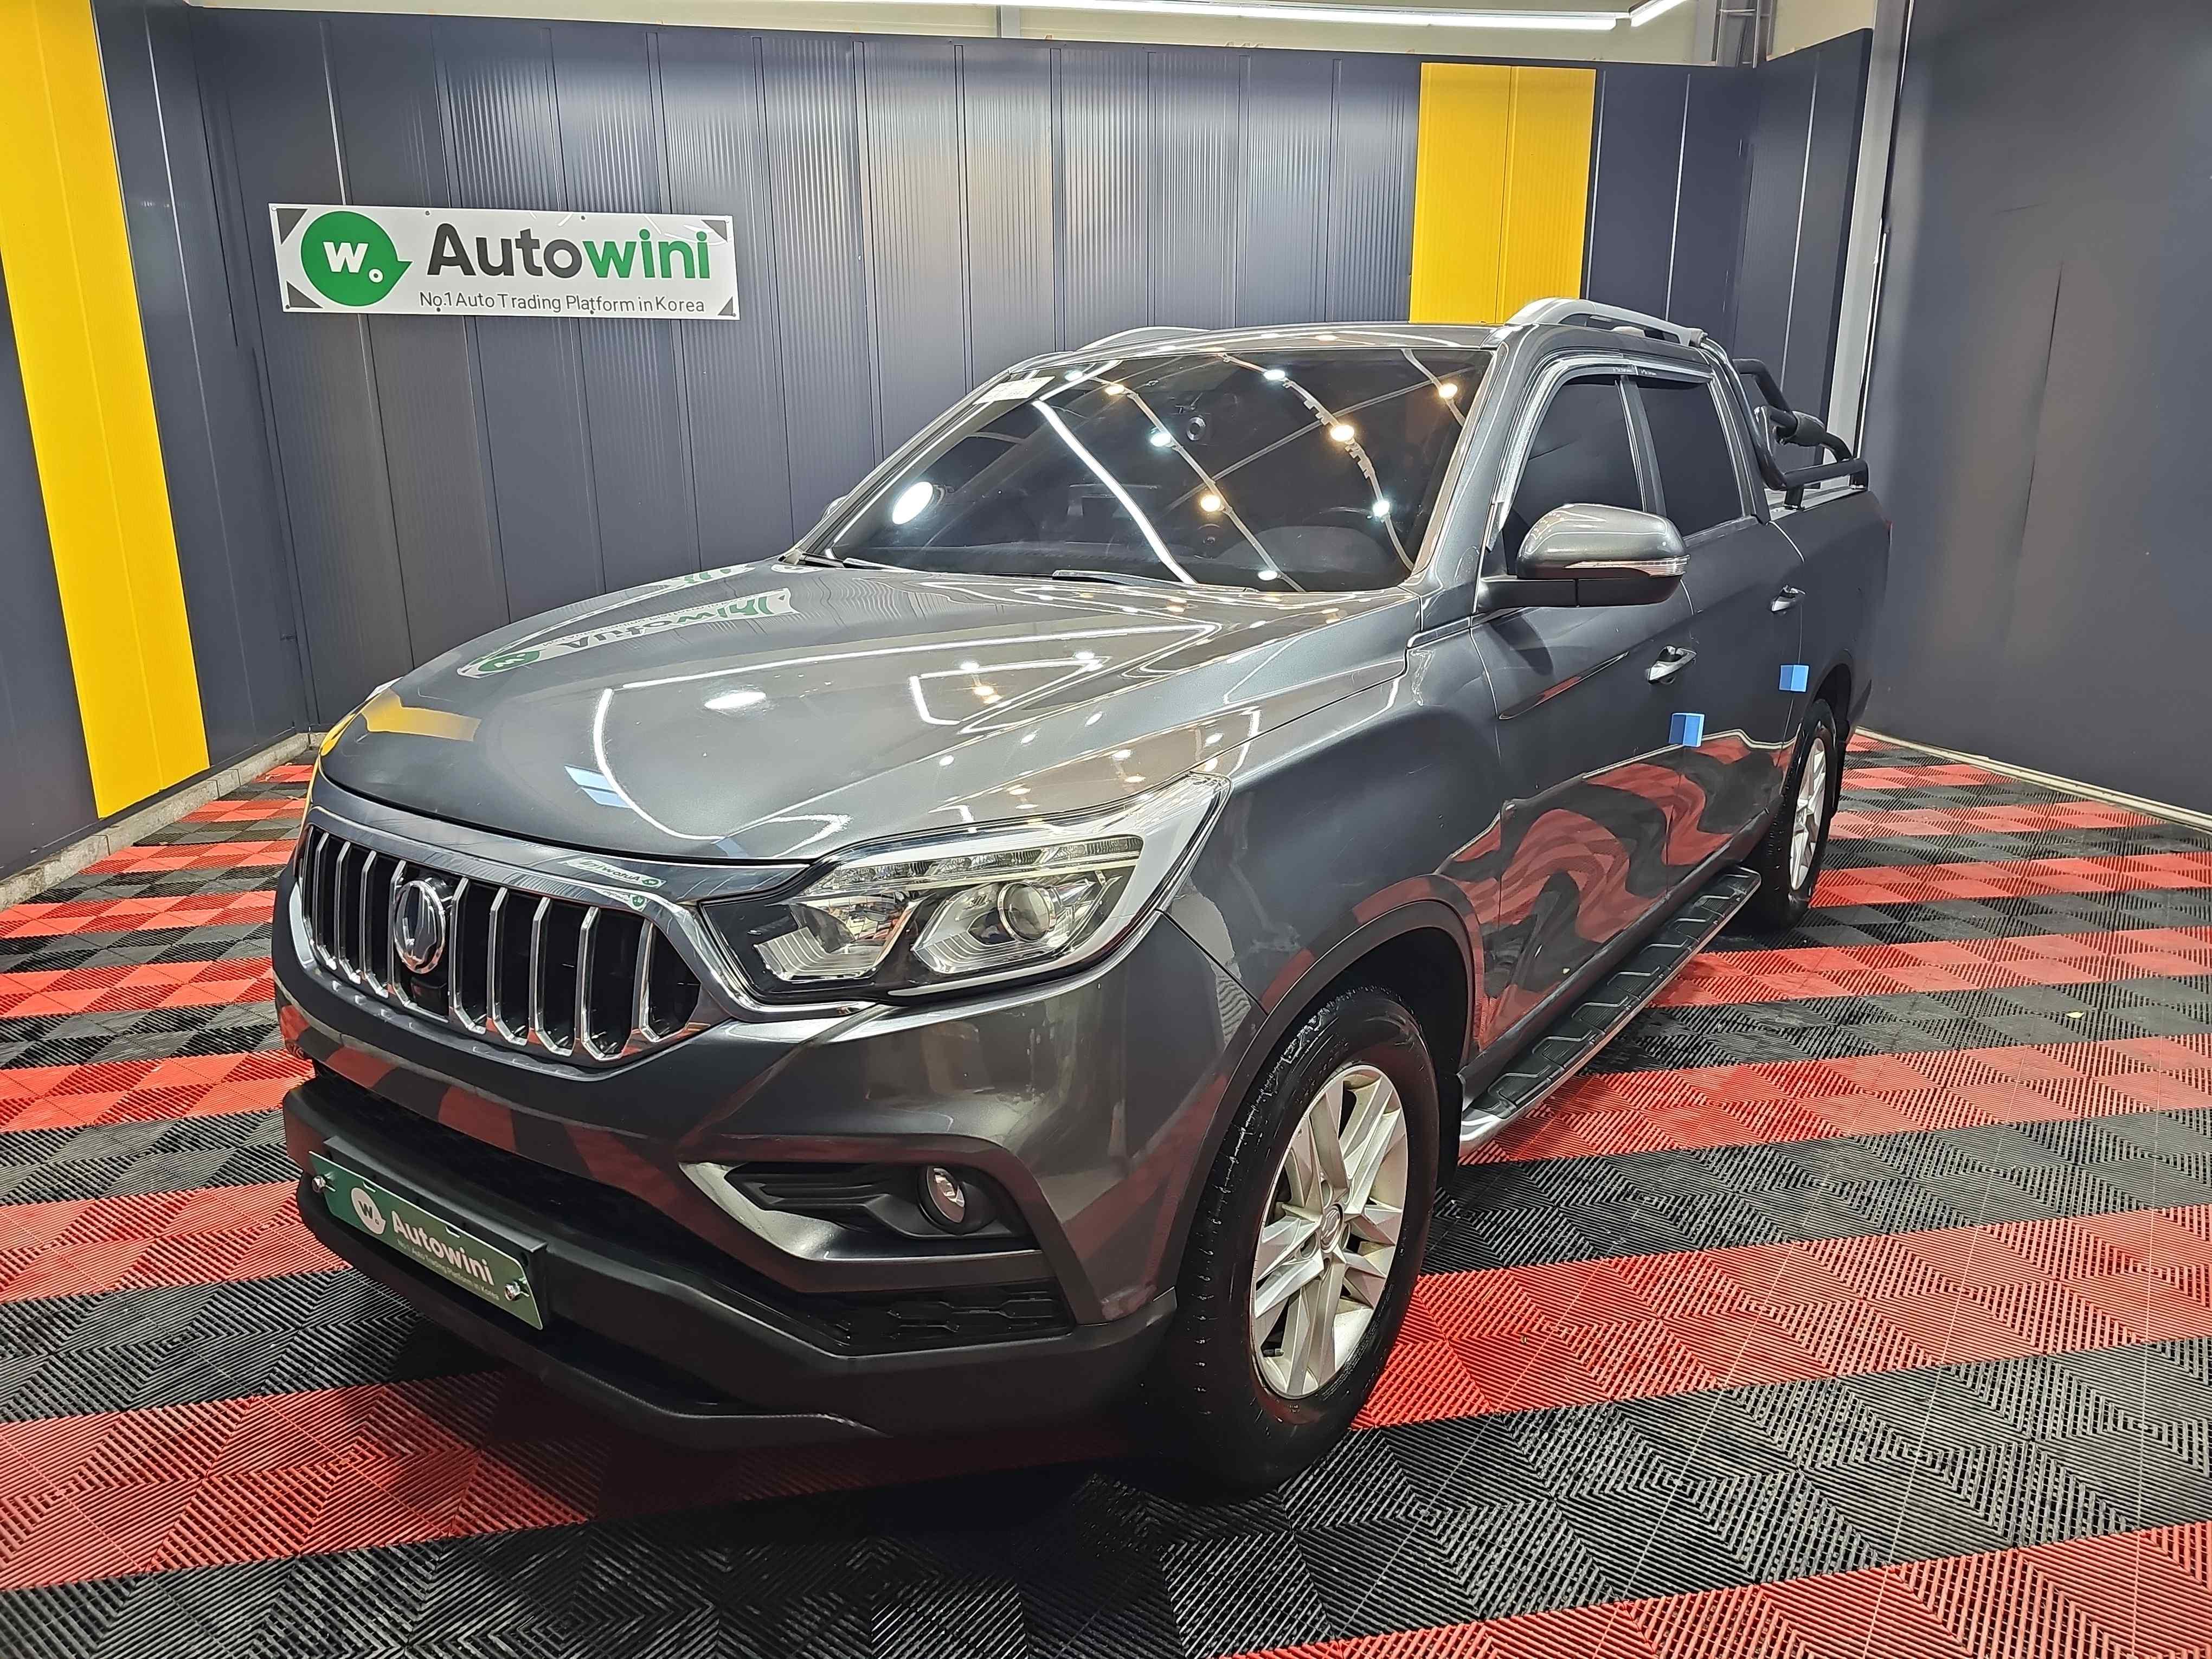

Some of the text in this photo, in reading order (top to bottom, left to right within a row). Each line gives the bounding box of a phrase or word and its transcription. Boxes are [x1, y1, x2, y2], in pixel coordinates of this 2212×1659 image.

[427, 222, 710, 279] Autowini
[420, 292, 705, 313] No.1 Auto Trading Platform in Korea
[391, 1210, 494, 1286] Autowini
